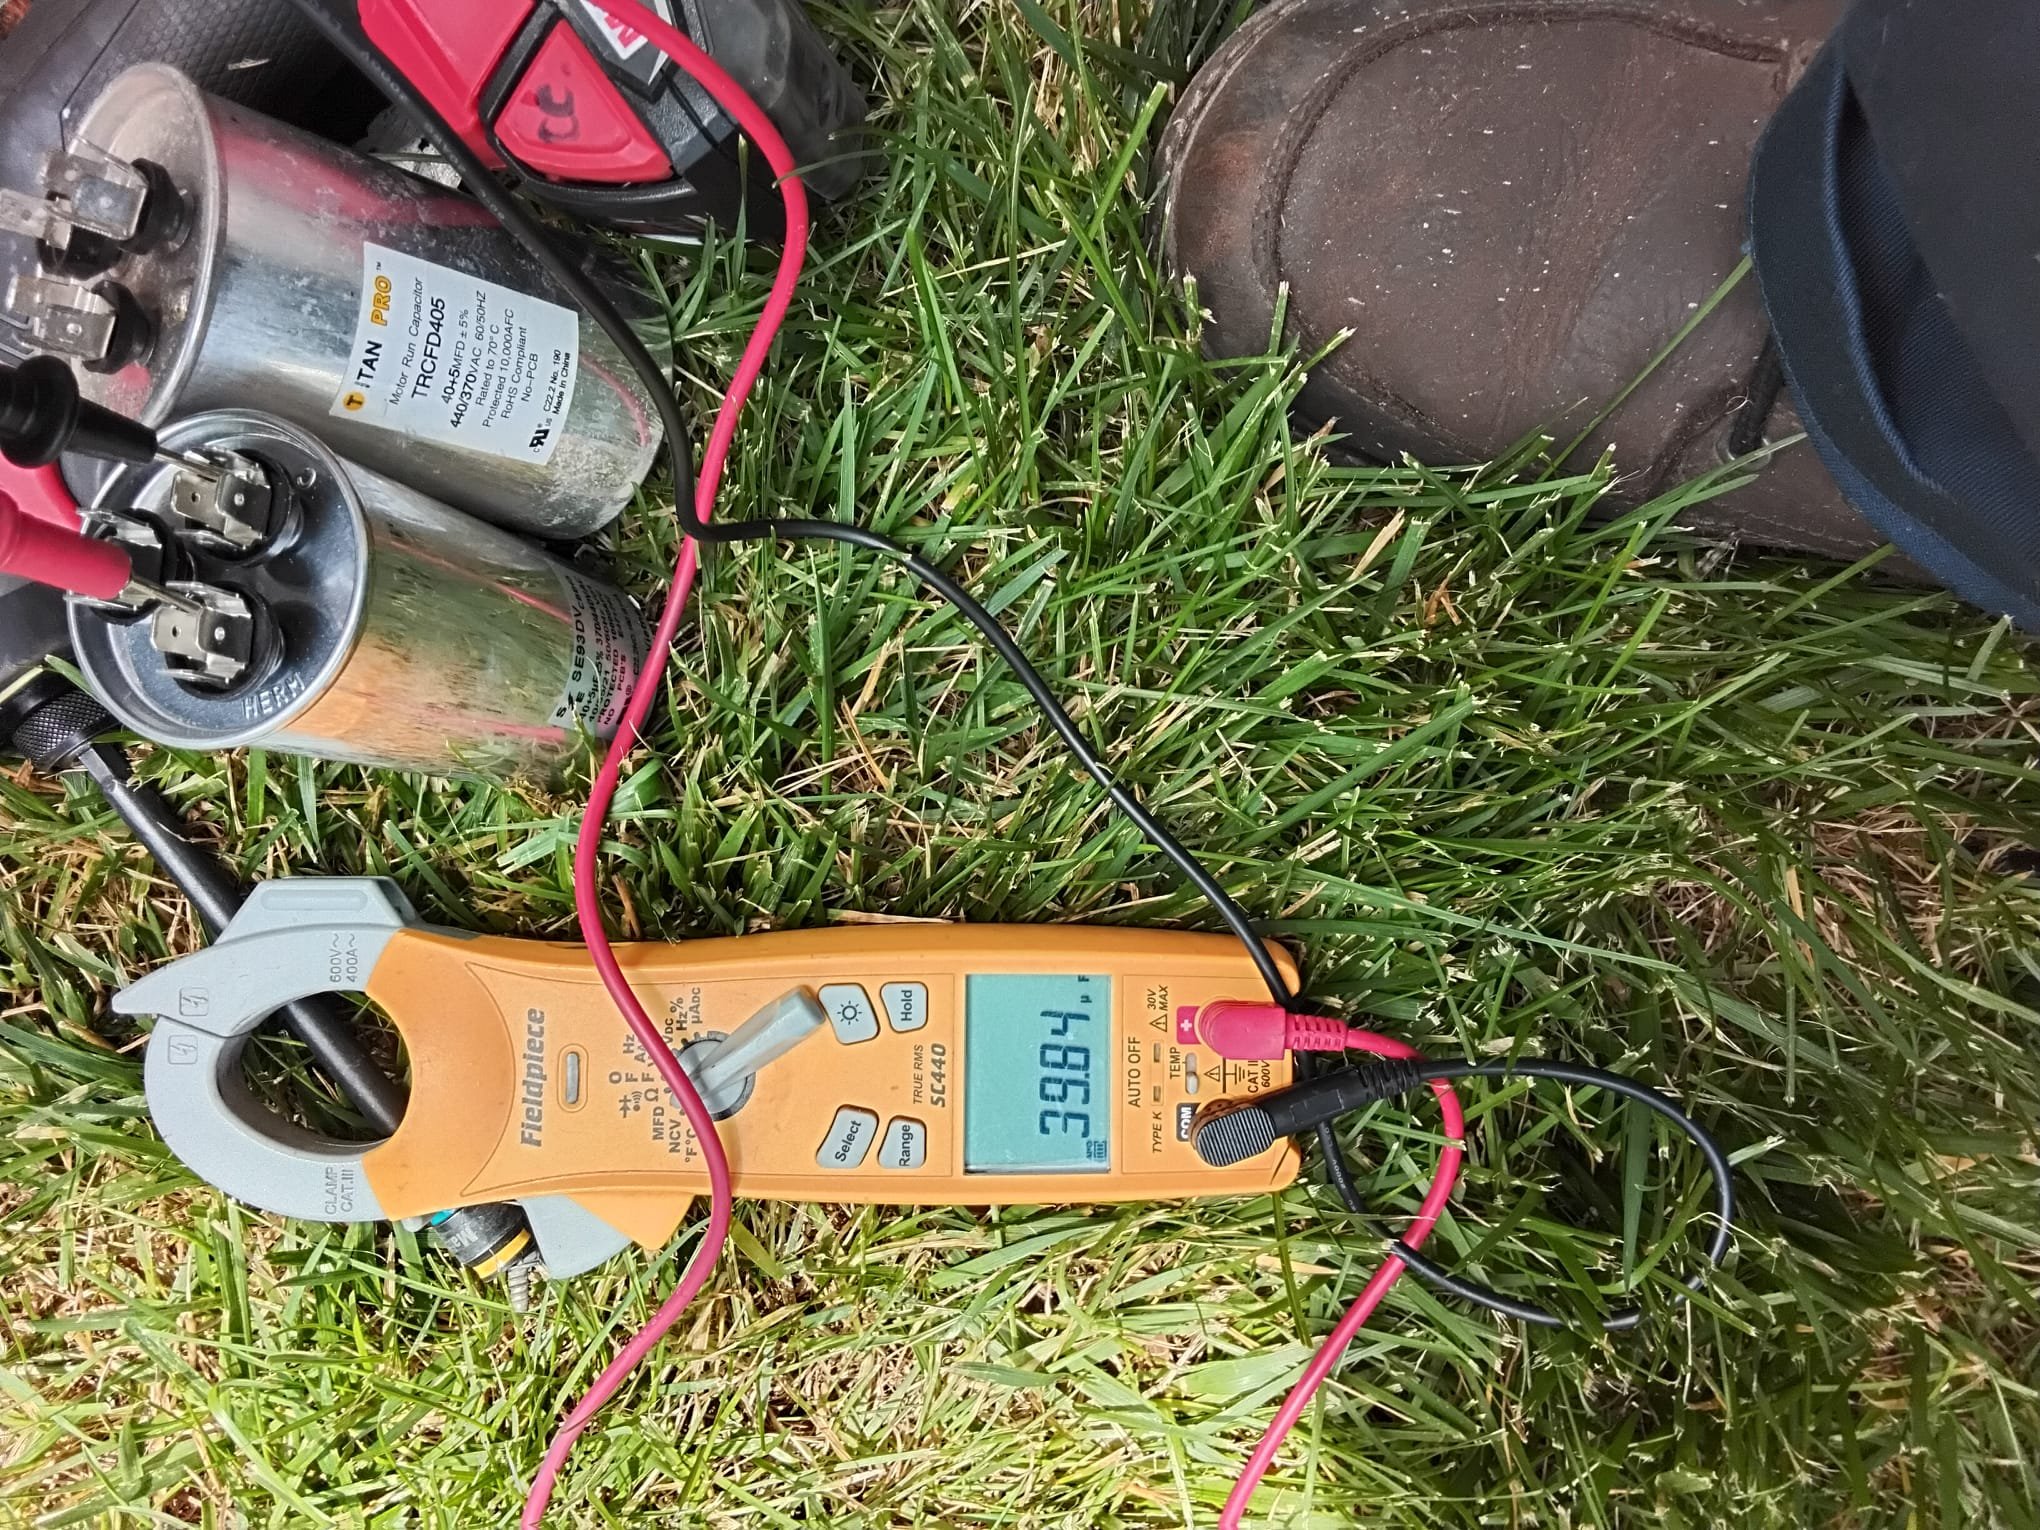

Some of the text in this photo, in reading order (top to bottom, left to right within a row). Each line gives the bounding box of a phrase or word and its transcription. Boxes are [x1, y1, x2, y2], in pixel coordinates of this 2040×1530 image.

[370, 275, 393, 327] PRO
[389, 277, 424, 406] Motor Run Capacitor
[411, 297, 446, 400] TRCFD405
[450, 290, 487, 429] 440/370VAC 60/50HZ
[440, 340, 467, 405] 40+5MFD
[475, 372, 490, 407] Rated
[487, 357, 495, 372] to
[482, 308, 515, 428] Protected 10,000AFC
[500, 326, 528, 420] RoHS Compliant
[543, 386, 557, 413] C22.2
[553, 349, 562, 364] 190
[552, 388, 566, 416] Made
[561, 352, 571, 379] China
[571, 604, 587, 682] SE93DV
[241, 671, 306, 721] HERM
[597, 649, 619, 723] PROTECTED
[604, 708, 615, 725] NO
[675, 1010, 688, 1032] Hz
[900, 989, 913, 1022] Hold
[1146, 988, 1158, 1010] 30V
[1158, 984, 1169, 1011] MAX
[623, 1034, 635, 1054] Hz
[1169, 1046, 1182, 1080] TEMP
[520, 1007, 548, 1148] Fieldpiece
[912, 1043, 924, 1105] TRUE RMS
[930, 1042, 947, 1109] SC440
[1038, 1009, 1092, 1139] 39.84
[1127, 1035, 1141, 1109] AUTO OFF
[1247, 1068, 1259, 1094] CAT
[1260, 1060, 1272, 1088] 600V
[652, 1105, 665, 1141] MFD
[668, 1118, 682, 1154] NCV
[834, 1119, 862, 1162] Select
[898, 1124, 914, 1168] Range
[1152, 1110, 1163, 1154] TYPE K
[324, 1166, 338, 1215] CLAMP
